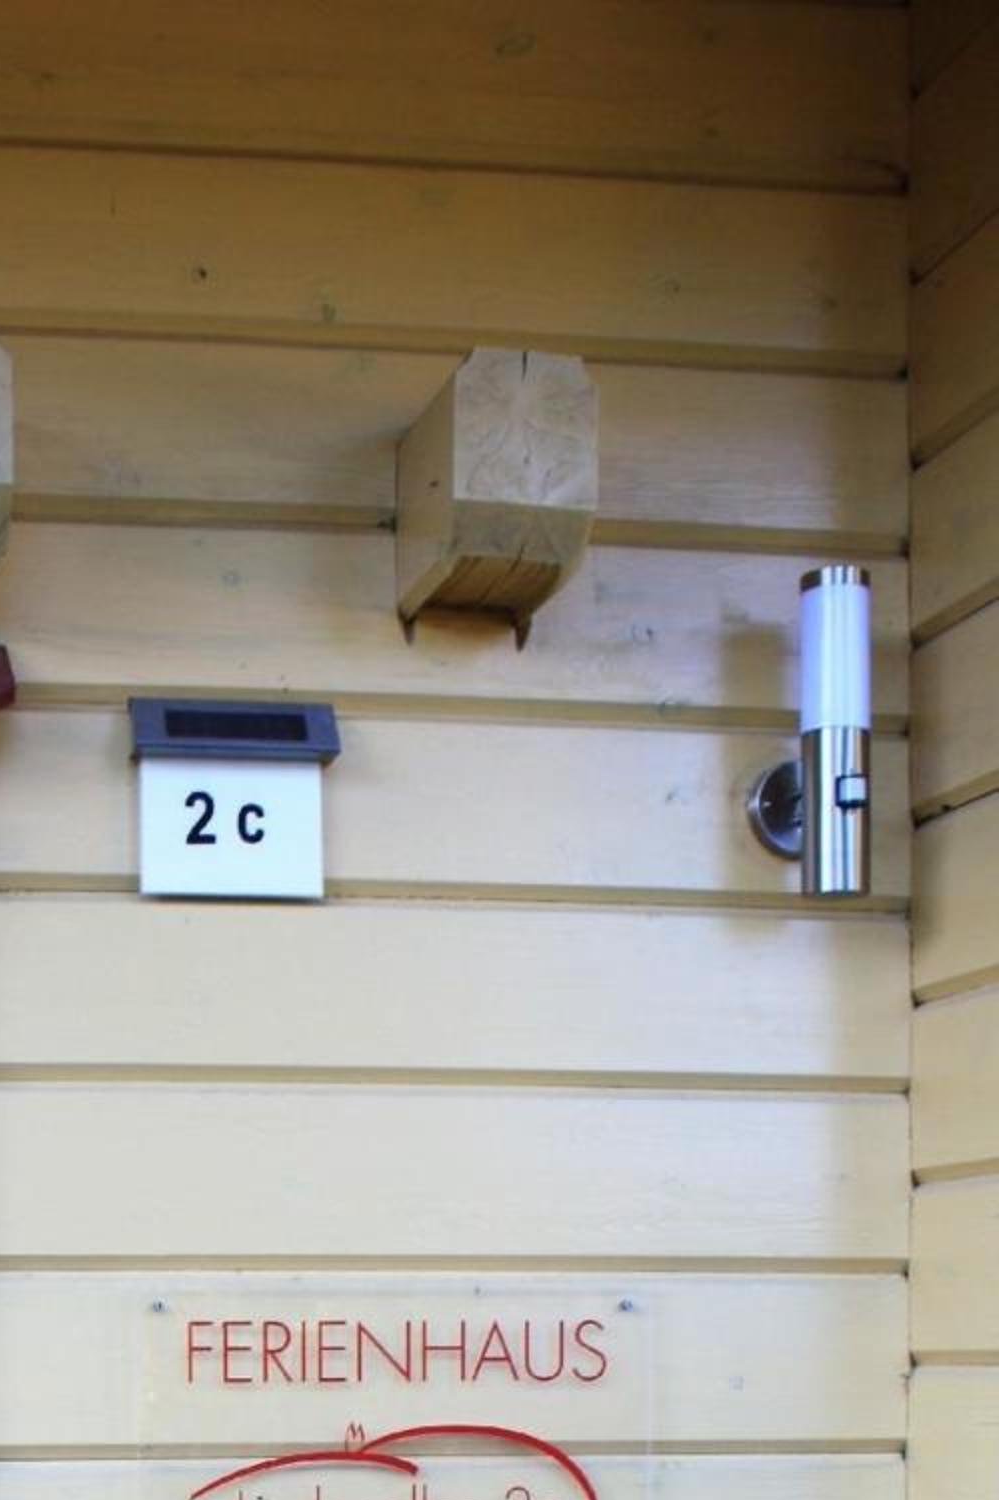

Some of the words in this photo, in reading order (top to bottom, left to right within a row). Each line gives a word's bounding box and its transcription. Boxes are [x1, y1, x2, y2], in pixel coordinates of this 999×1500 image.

[185, 791, 217, 845] 2
[237, 803, 265, 844] c
[186, 1319, 608, 1384] FERIENHAUS
